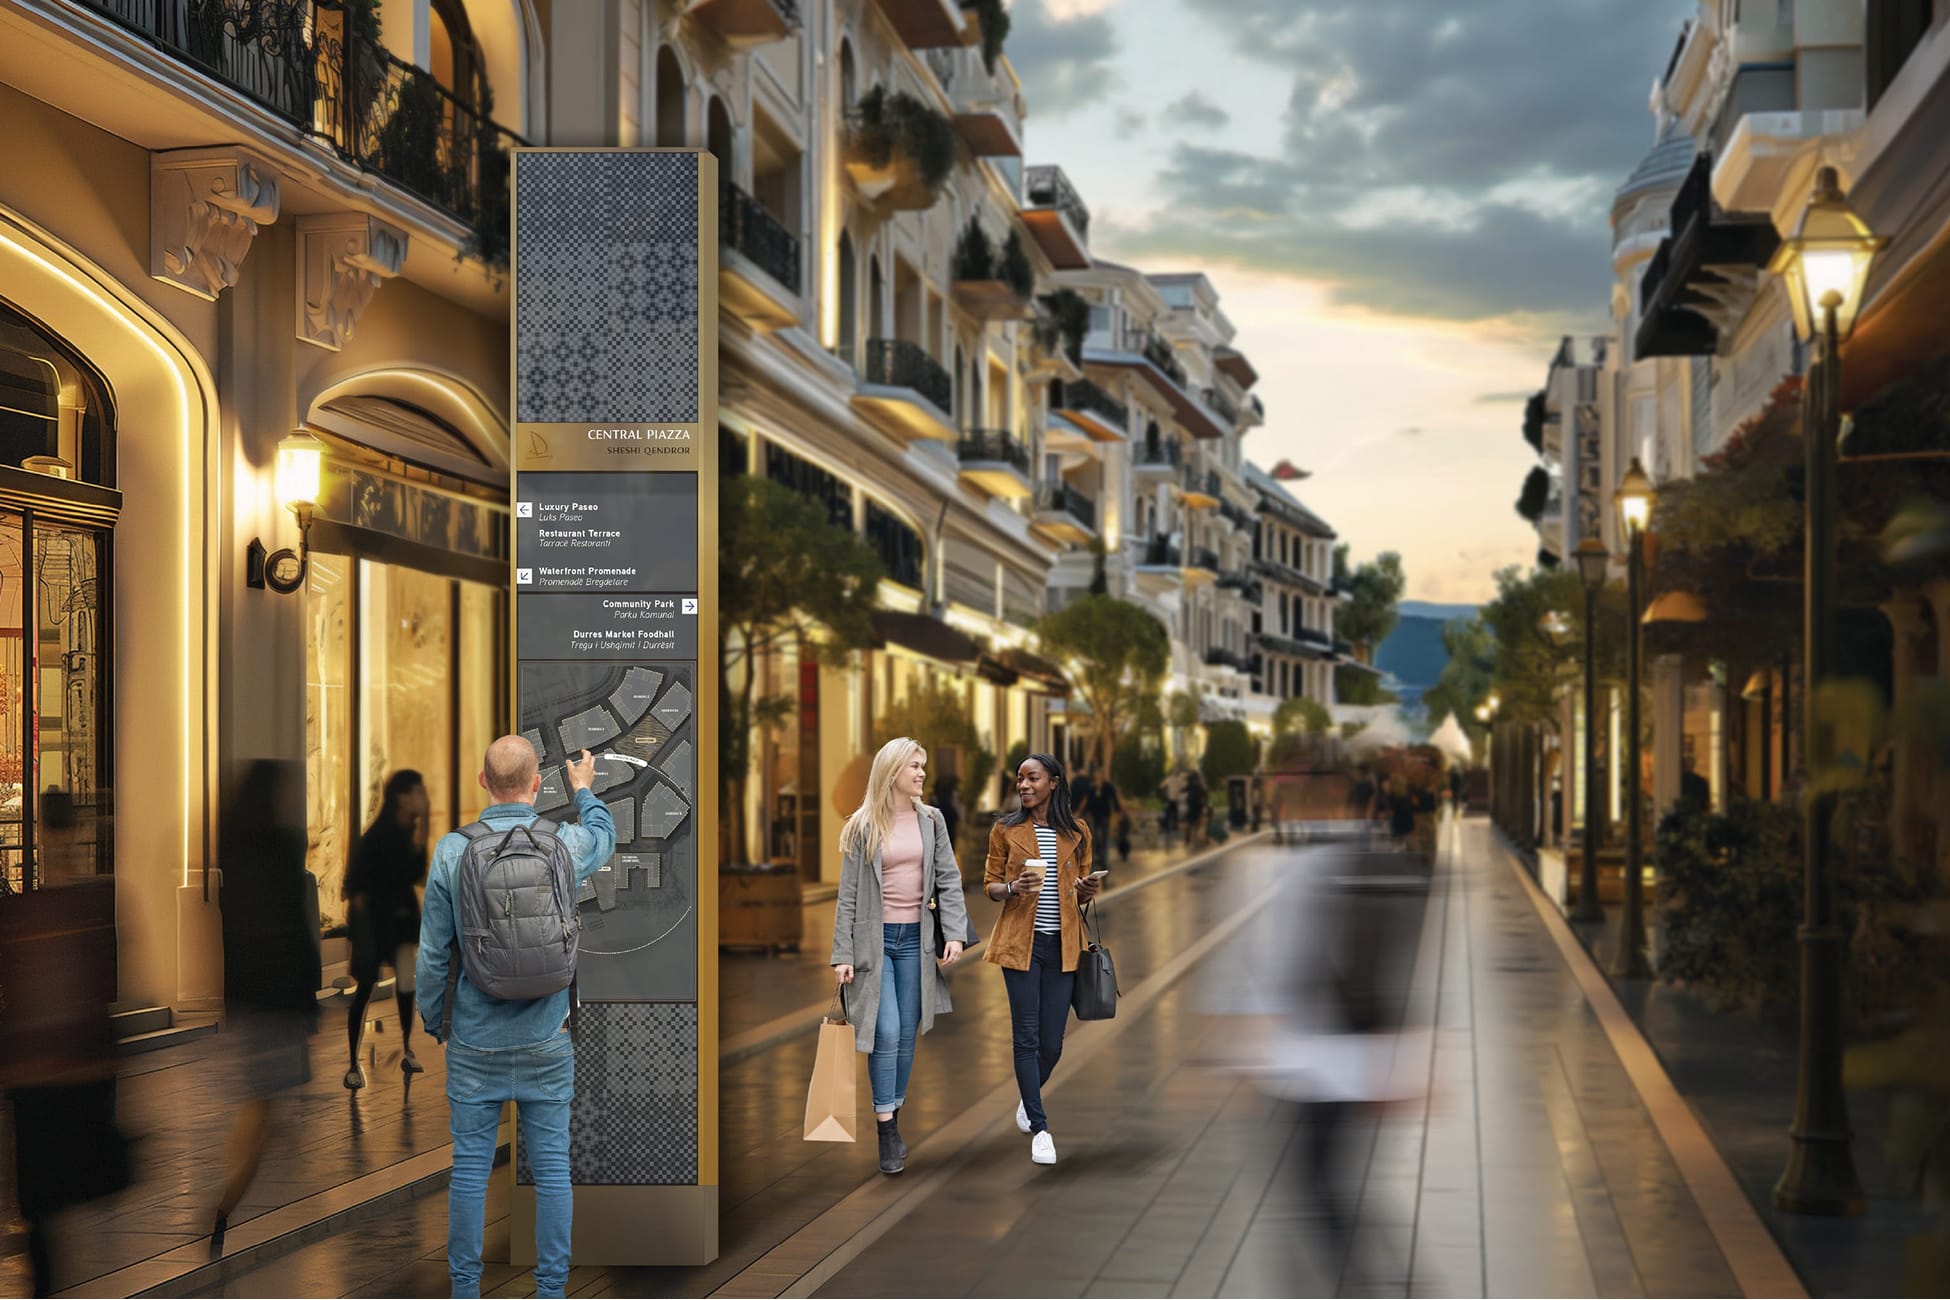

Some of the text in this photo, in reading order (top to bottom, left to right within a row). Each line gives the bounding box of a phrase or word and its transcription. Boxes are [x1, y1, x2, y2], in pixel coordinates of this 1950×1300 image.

[587, 429, 691, 440] CENTRAL PIAZZA
[607, 447, 690, 456] SHESHI QENDROR
[539, 503, 599, 513] Luxury Paseo
[539, 513, 583, 522] Luks Paseo
[539, 529, 621, 538] Restaurant Terrace
[539, 567, 637, 575] Waterfront Promenade
[602, 599, 675, 609] Community Park
[613, 610, 675, 619] Parku Komunal
[573, 630, 675, 638] Durres Market Foodhall
[571, 641, 594, 652] Tregu
